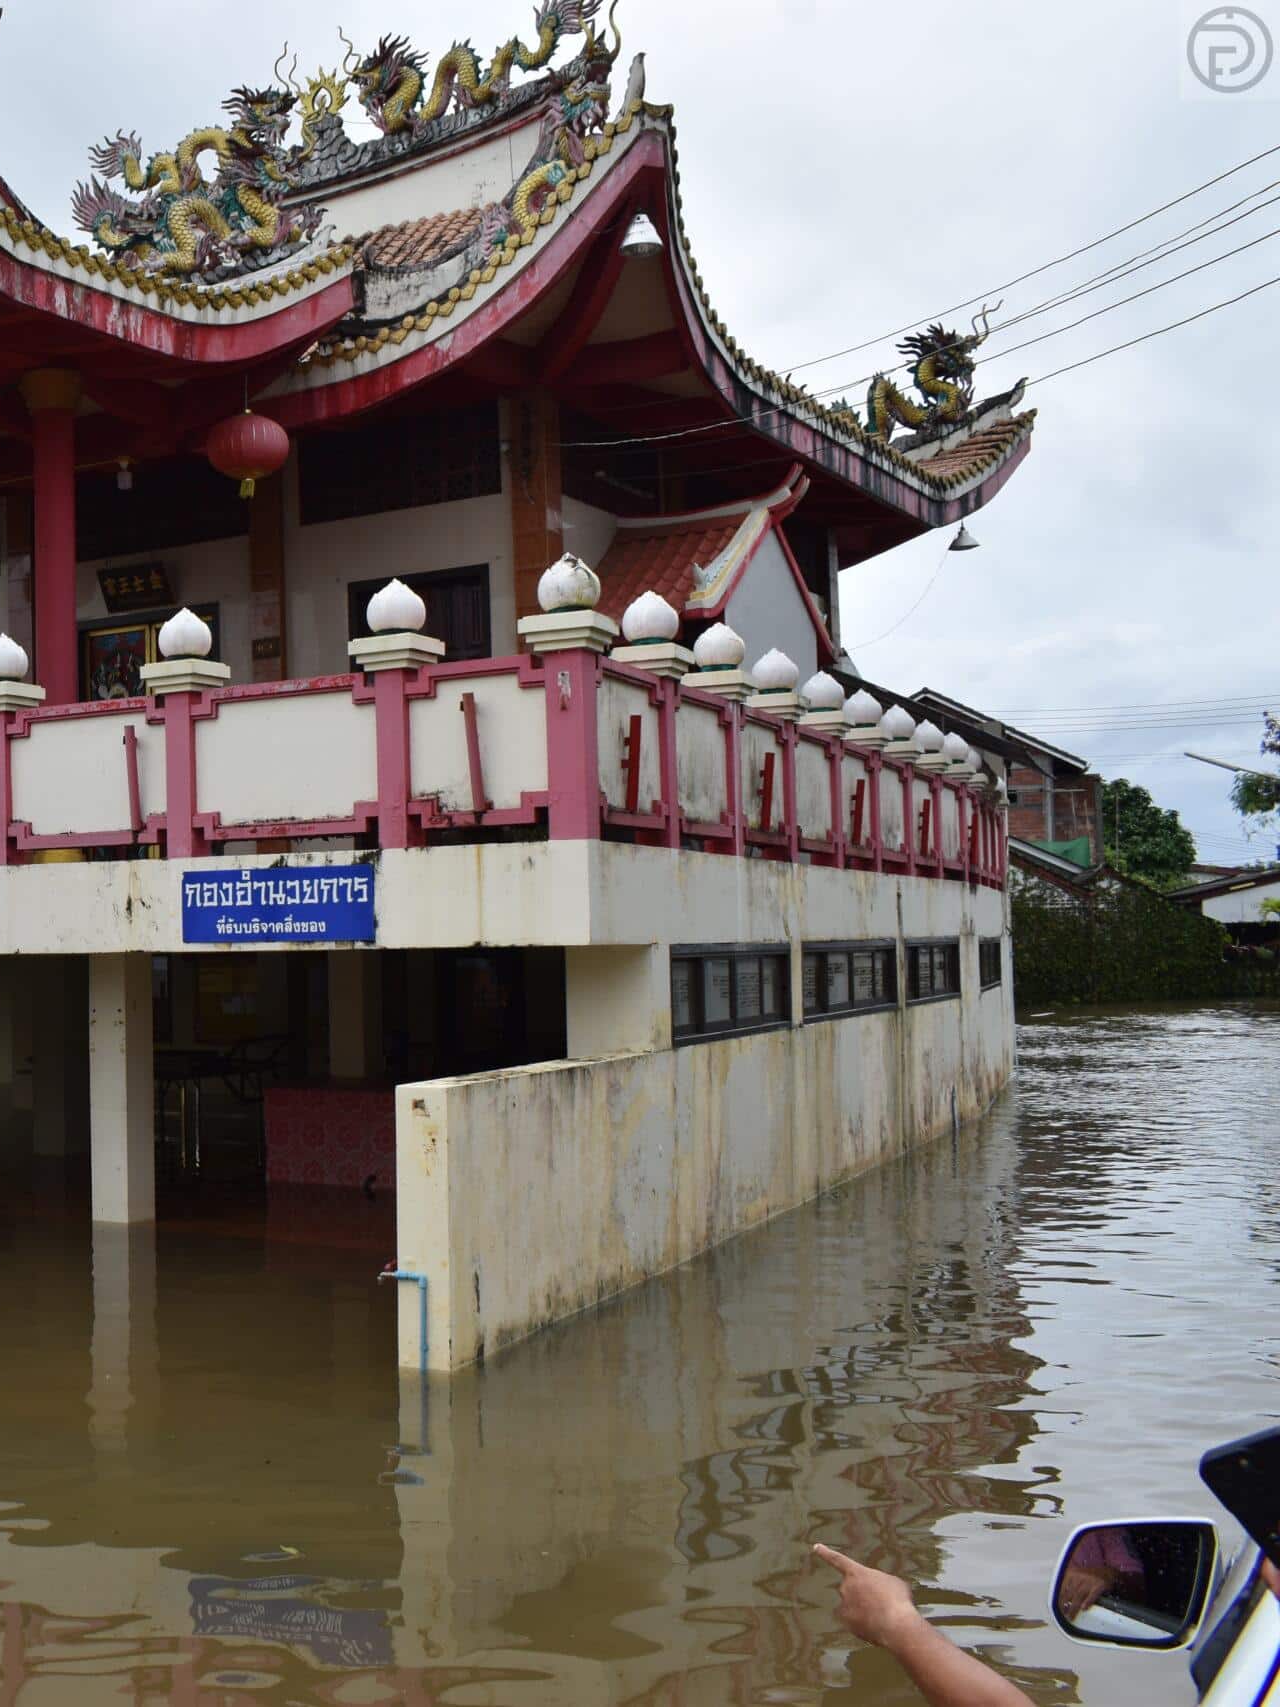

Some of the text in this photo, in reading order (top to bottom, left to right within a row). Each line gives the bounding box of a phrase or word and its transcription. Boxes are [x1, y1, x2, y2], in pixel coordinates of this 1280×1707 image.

[185, 870, 369, 908] กองอำนวยการ
[216, 914, 326, 935] ที่รับบริจาคสิ่งของ
